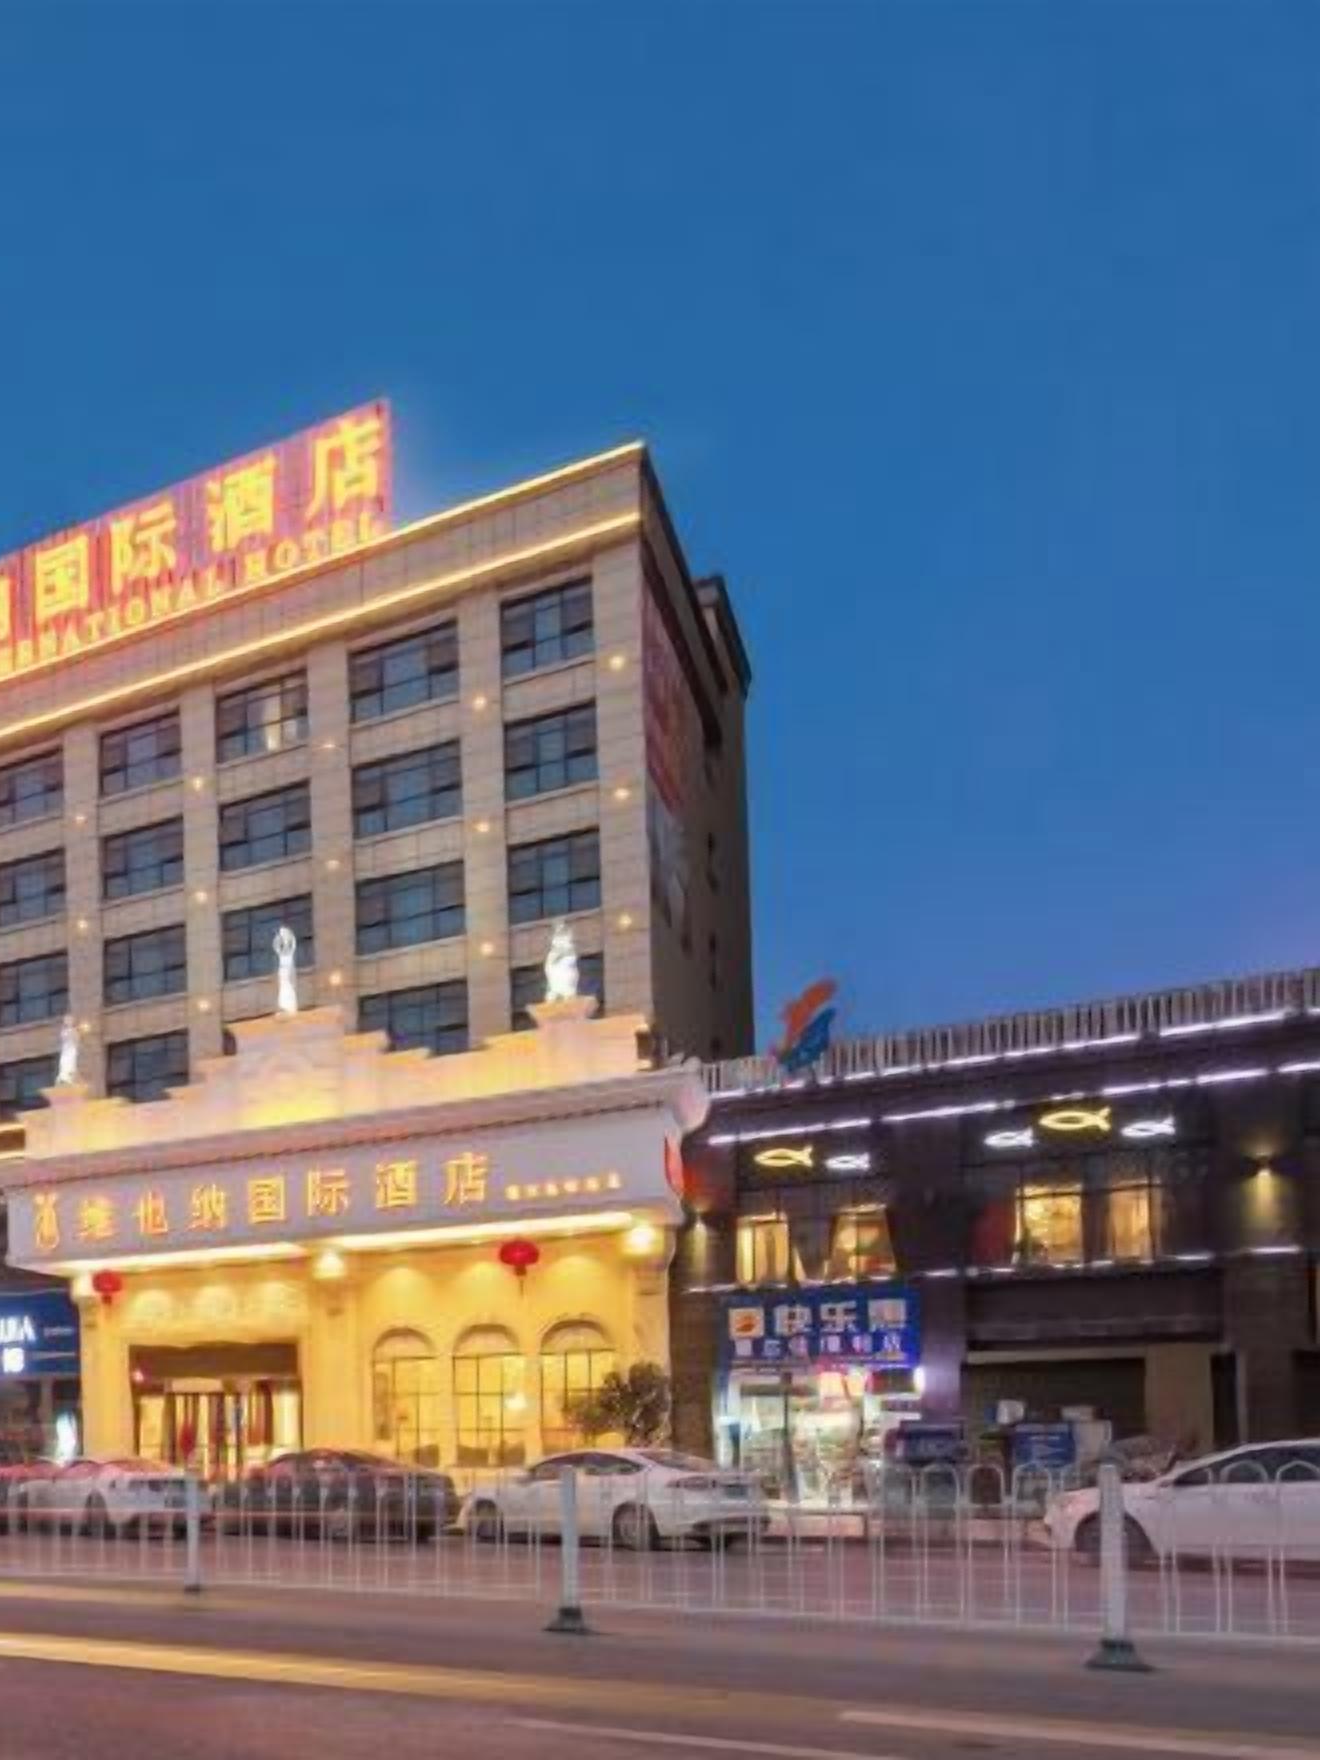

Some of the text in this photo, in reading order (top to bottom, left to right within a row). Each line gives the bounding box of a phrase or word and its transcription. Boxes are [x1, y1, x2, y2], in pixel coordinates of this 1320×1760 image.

[243, 509, 383, 577] HOTEL
[76, 1151, 488, 1240] 维也纳国际酒店
